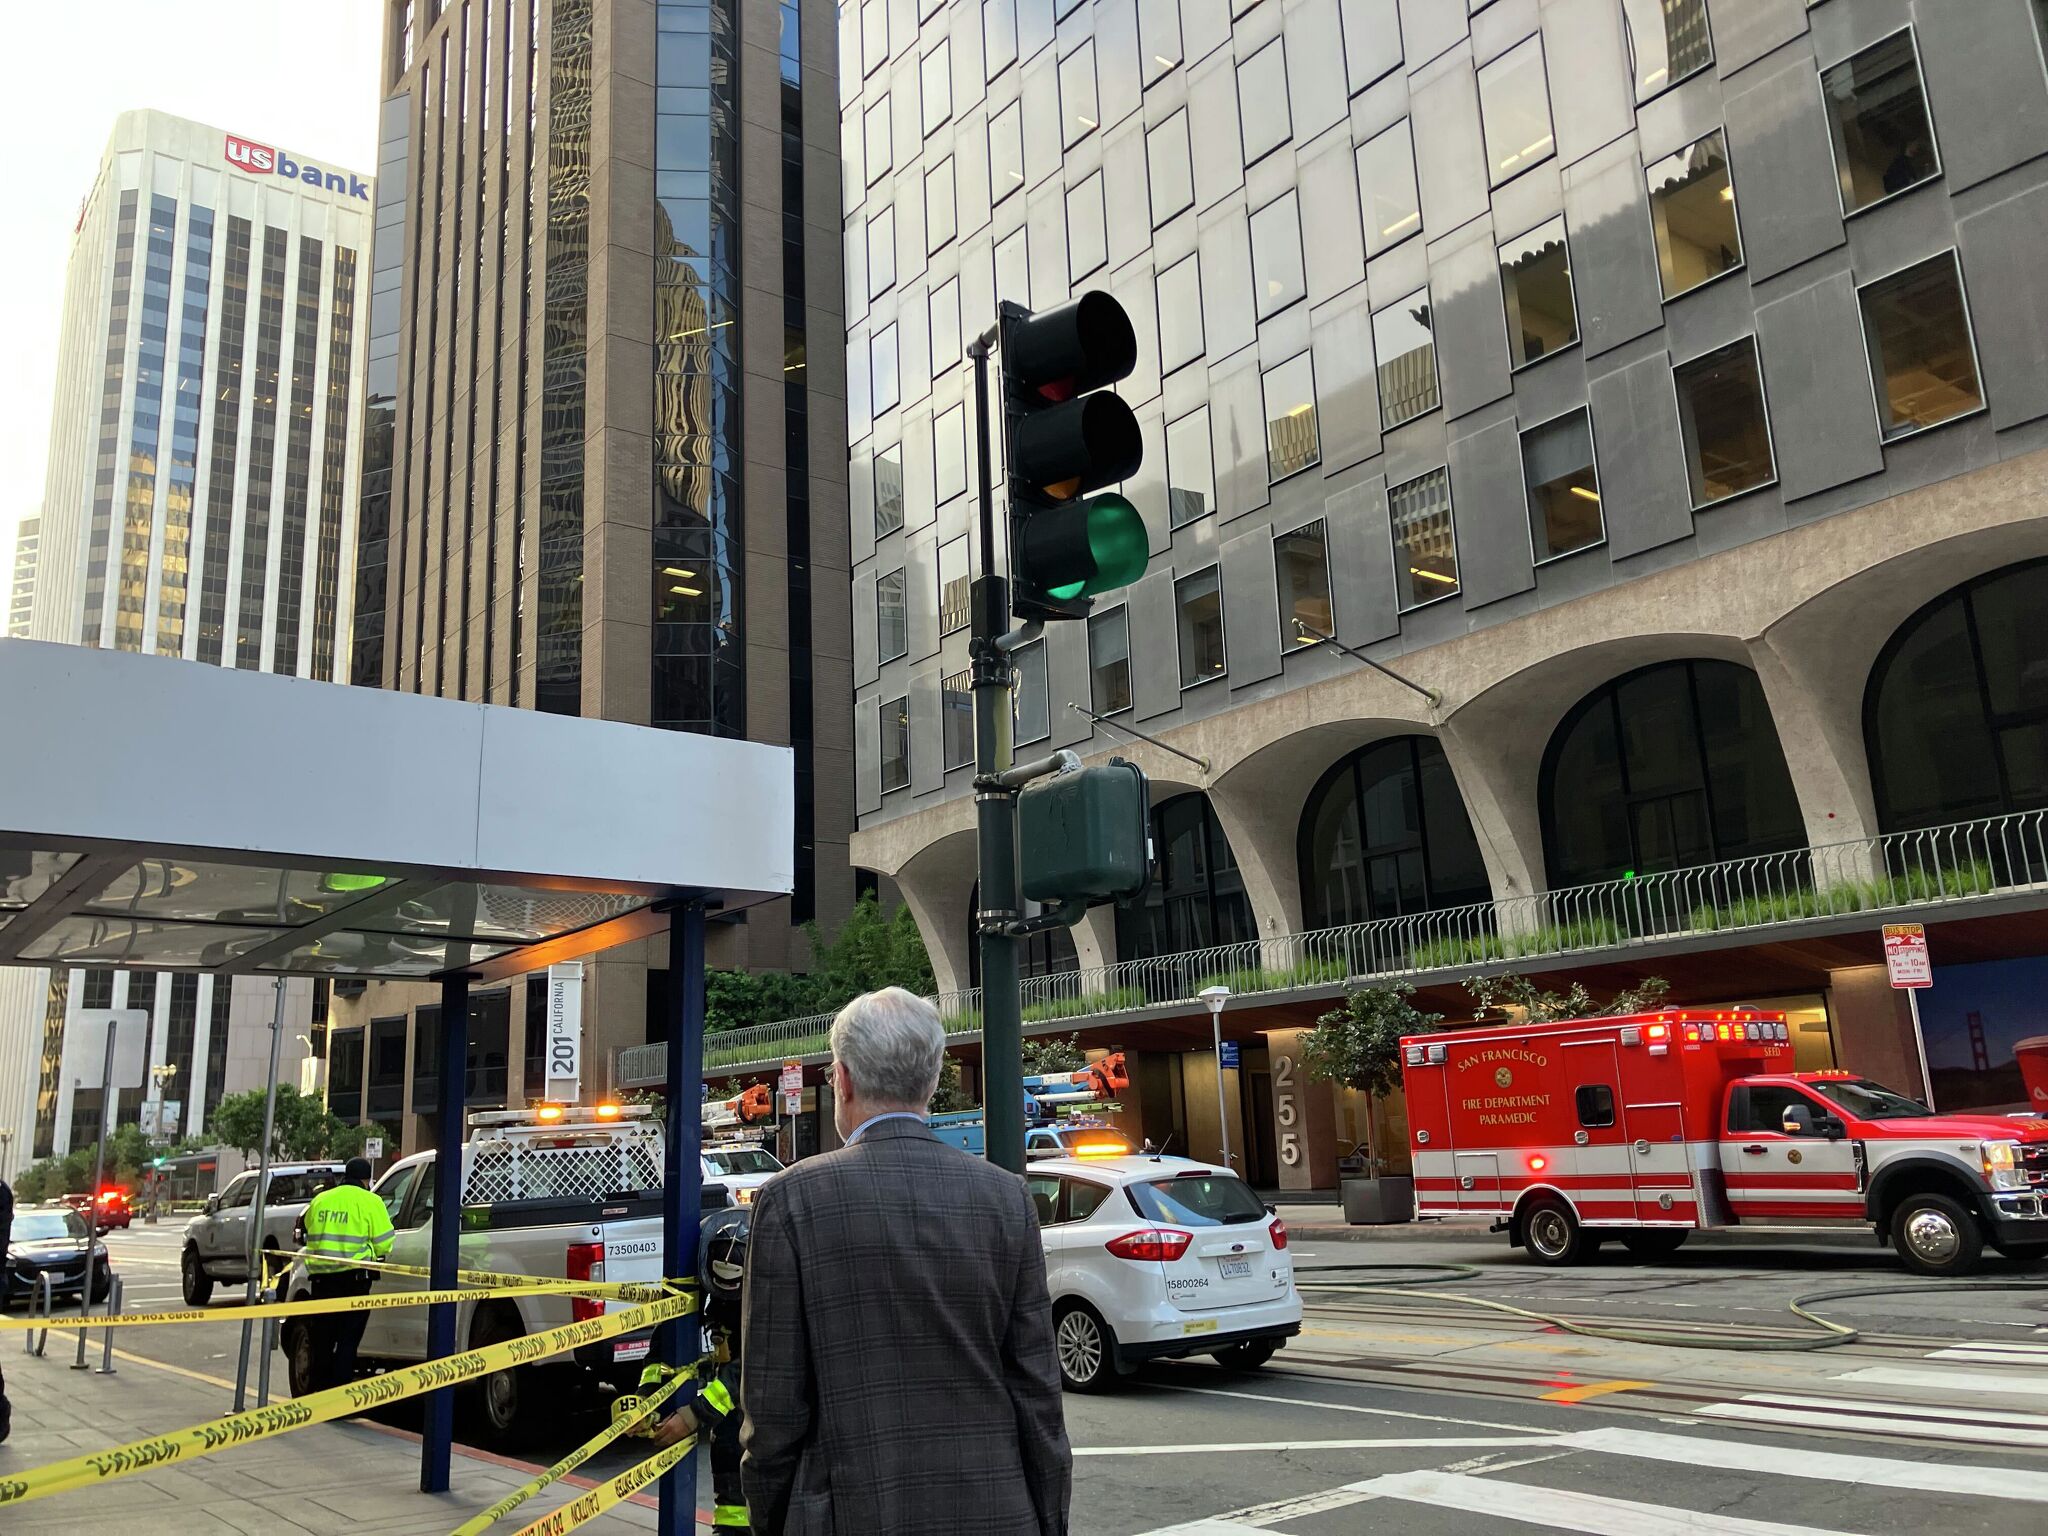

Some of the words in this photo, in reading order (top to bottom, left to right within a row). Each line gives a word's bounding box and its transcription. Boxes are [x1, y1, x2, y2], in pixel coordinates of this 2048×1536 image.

[277, 151, 369, 201] bank
[1903, 926, 1921, 934] STOP
[1887, 945, 1898, 955] NO
[553, 981, 564, 1034] CALIFORNIA
[552, 1037, 574, 1074] 201
[1457, 1055, 1479, 1072] SAN
[1481, 1049, 1547, 1067] FRANCISCO
[1275, 1055, 1300, 1165] 255
[1462, 1099, 1482, 1110] FIRE
[1484, 1094, 1551, 1109] DEPARTMENT
[1479, 1112, 1537, 1125] PARAMEDIC
[608, 1242, 657, 1256] 73500403
[1167, 1278, 1209, 1289] 15800264
[614, 1471, 635, 1498] ENTER
[571, 1492, 600, 1526] CAUTION
[552, 1512, 564, 1534] DO
